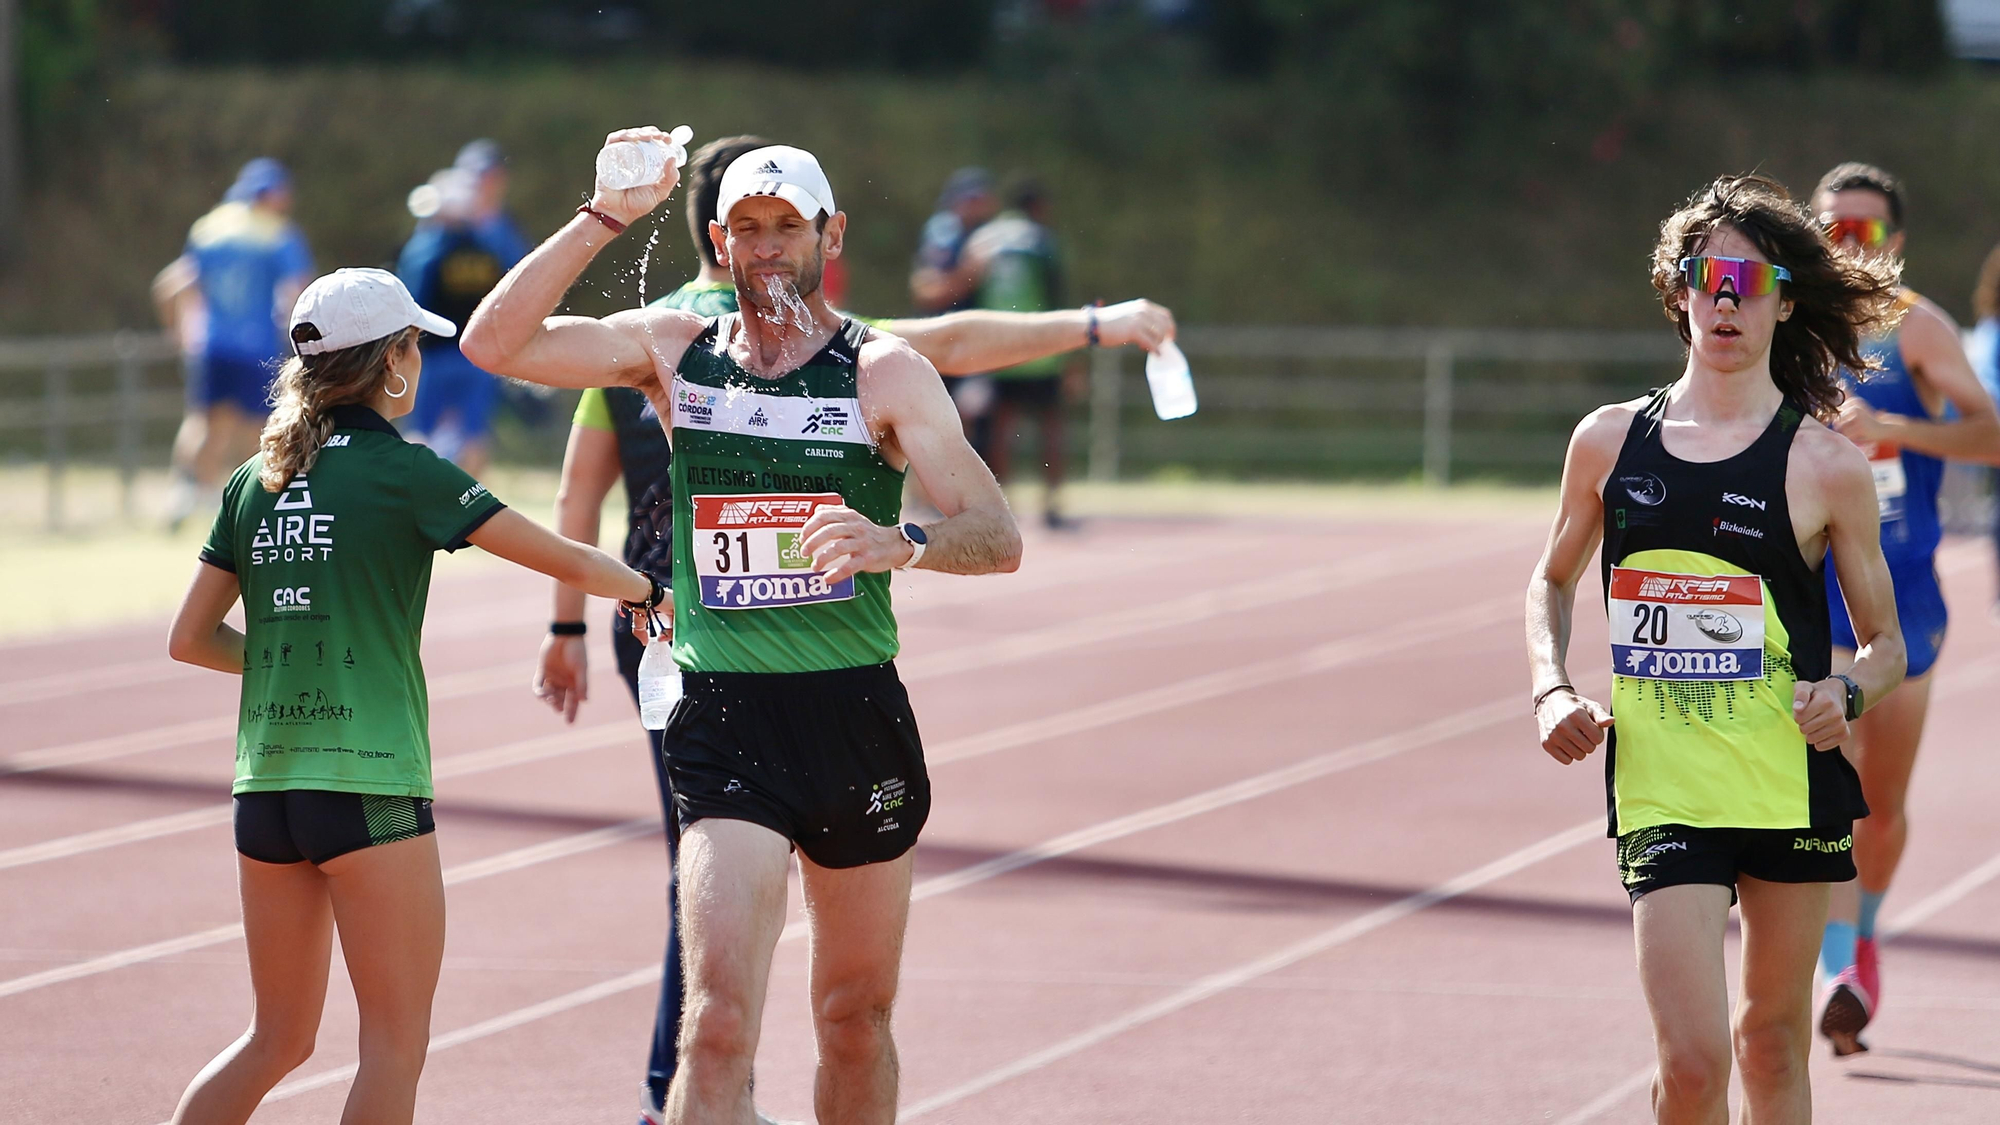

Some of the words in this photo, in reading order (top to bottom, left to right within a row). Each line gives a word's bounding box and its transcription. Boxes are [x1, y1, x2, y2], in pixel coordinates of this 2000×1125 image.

[678, 402, 713, 416] CÓRDOBA
[820, 427, 844, 435] CAC
[805, 448, 844, 459] CARLITOS
[687, 465, 756, 488] ATLETISMO
[761, 472, 843, 492] CORDOBÉS
[750, 500, 813, 517] RFEA
[748, 516, 809, 525] ATLETISMO
[252, 514, 335, 548] AIRE
[1719, 520, 1764, 539] Bizkaialde
[252, 547, 333, 565] SPORT
[713, 531, 750, 574] 31
[1669, 578, 1731, 594] RFEA
[273, 587, 311, 606] CAC
[1665, 593, 1726, 601] ATLETISMO
[1632, 603, 1668, 646] 20
[374, 750, 395, 760] team
[883, 797, 903, 810] CAC
[1793, 834, 1852, 853] DURANGO
